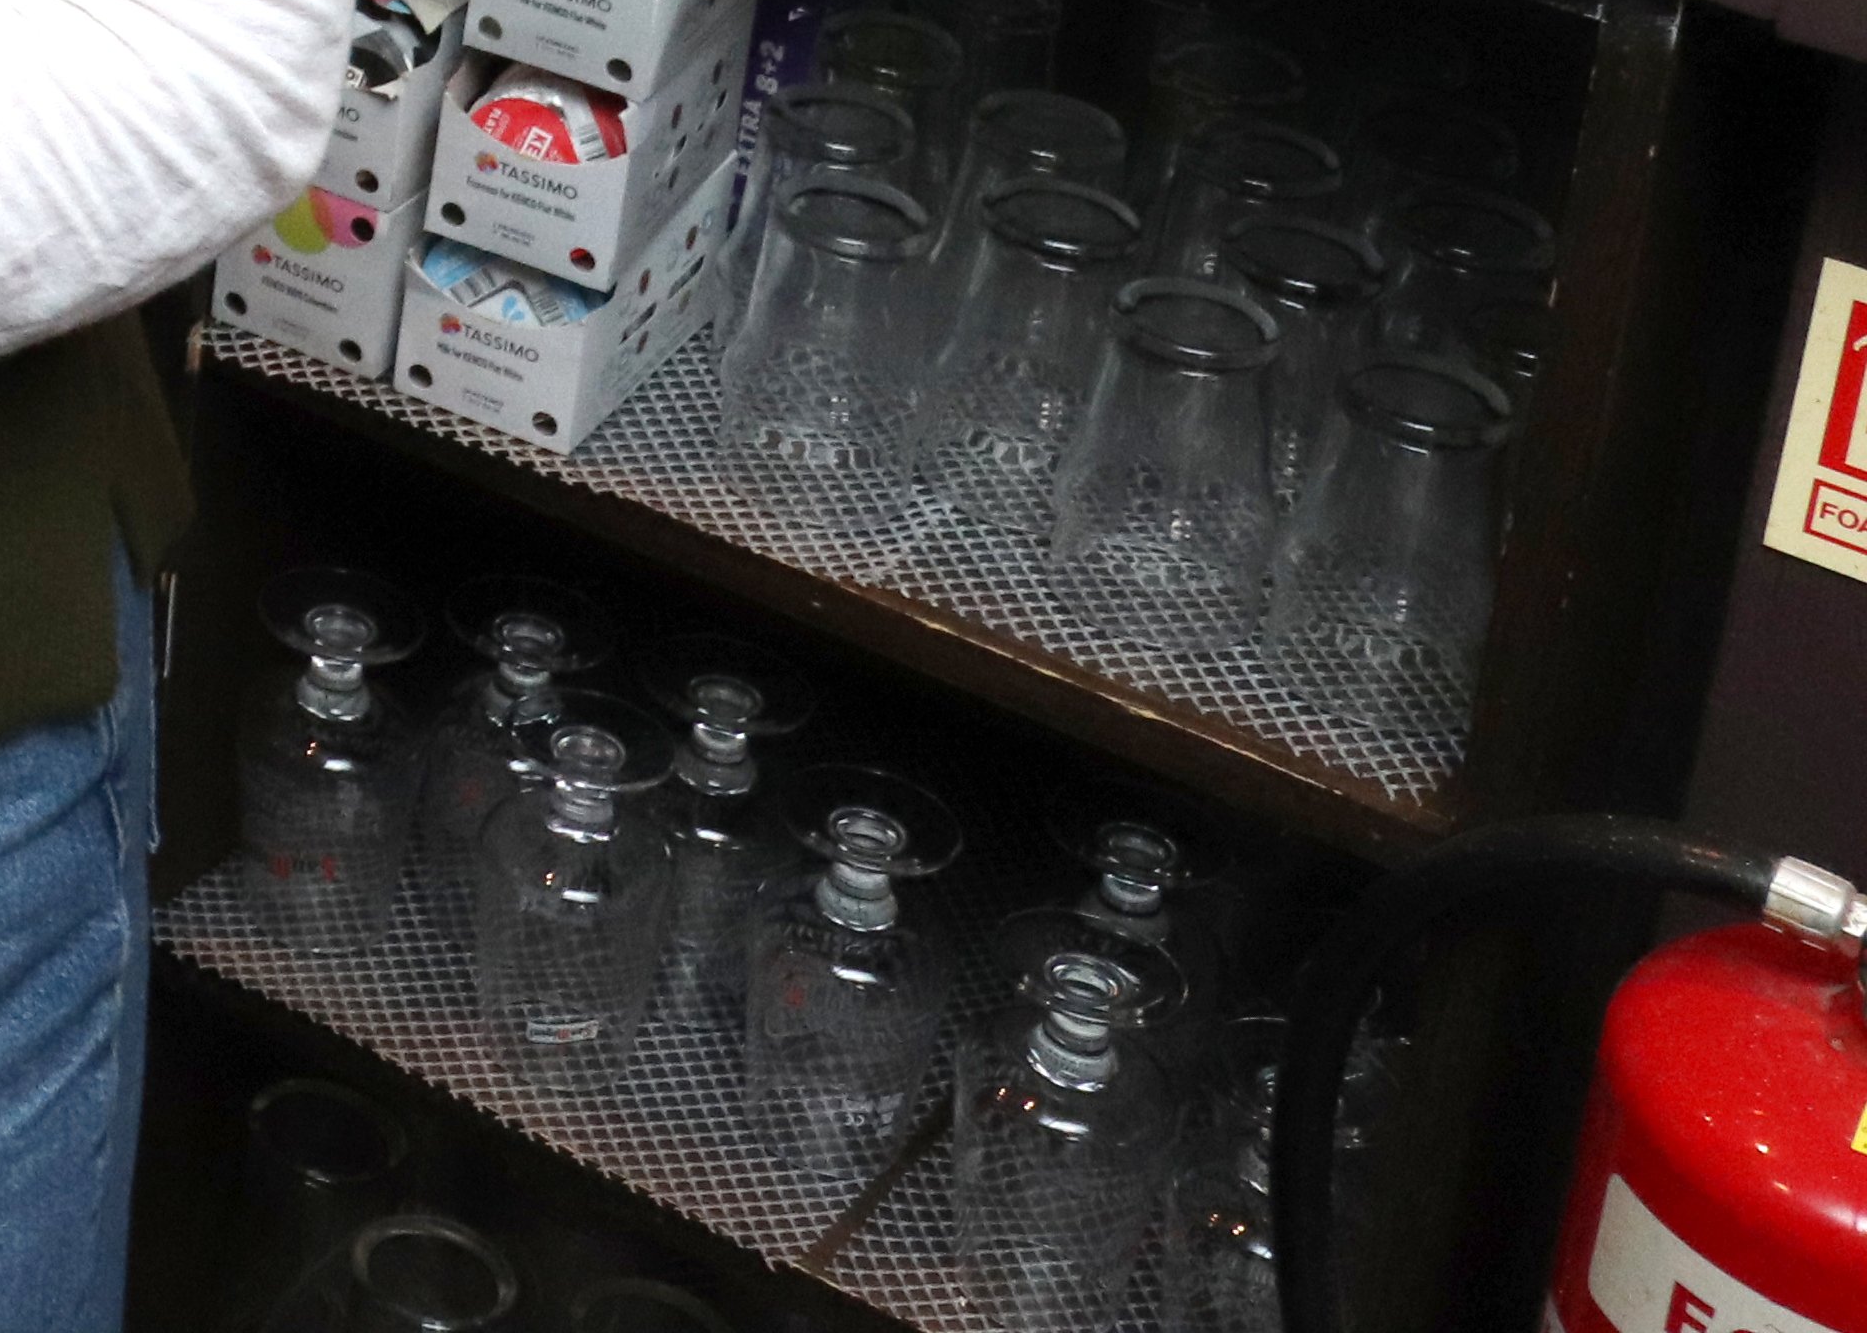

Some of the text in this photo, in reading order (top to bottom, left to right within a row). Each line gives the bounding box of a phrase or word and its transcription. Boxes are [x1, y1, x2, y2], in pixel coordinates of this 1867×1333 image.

[499, 161, 578, 200] TASSIMO
[273, 255, 344, 294] TASSIMO
[462, 323, 540, 362] TASSIMO
